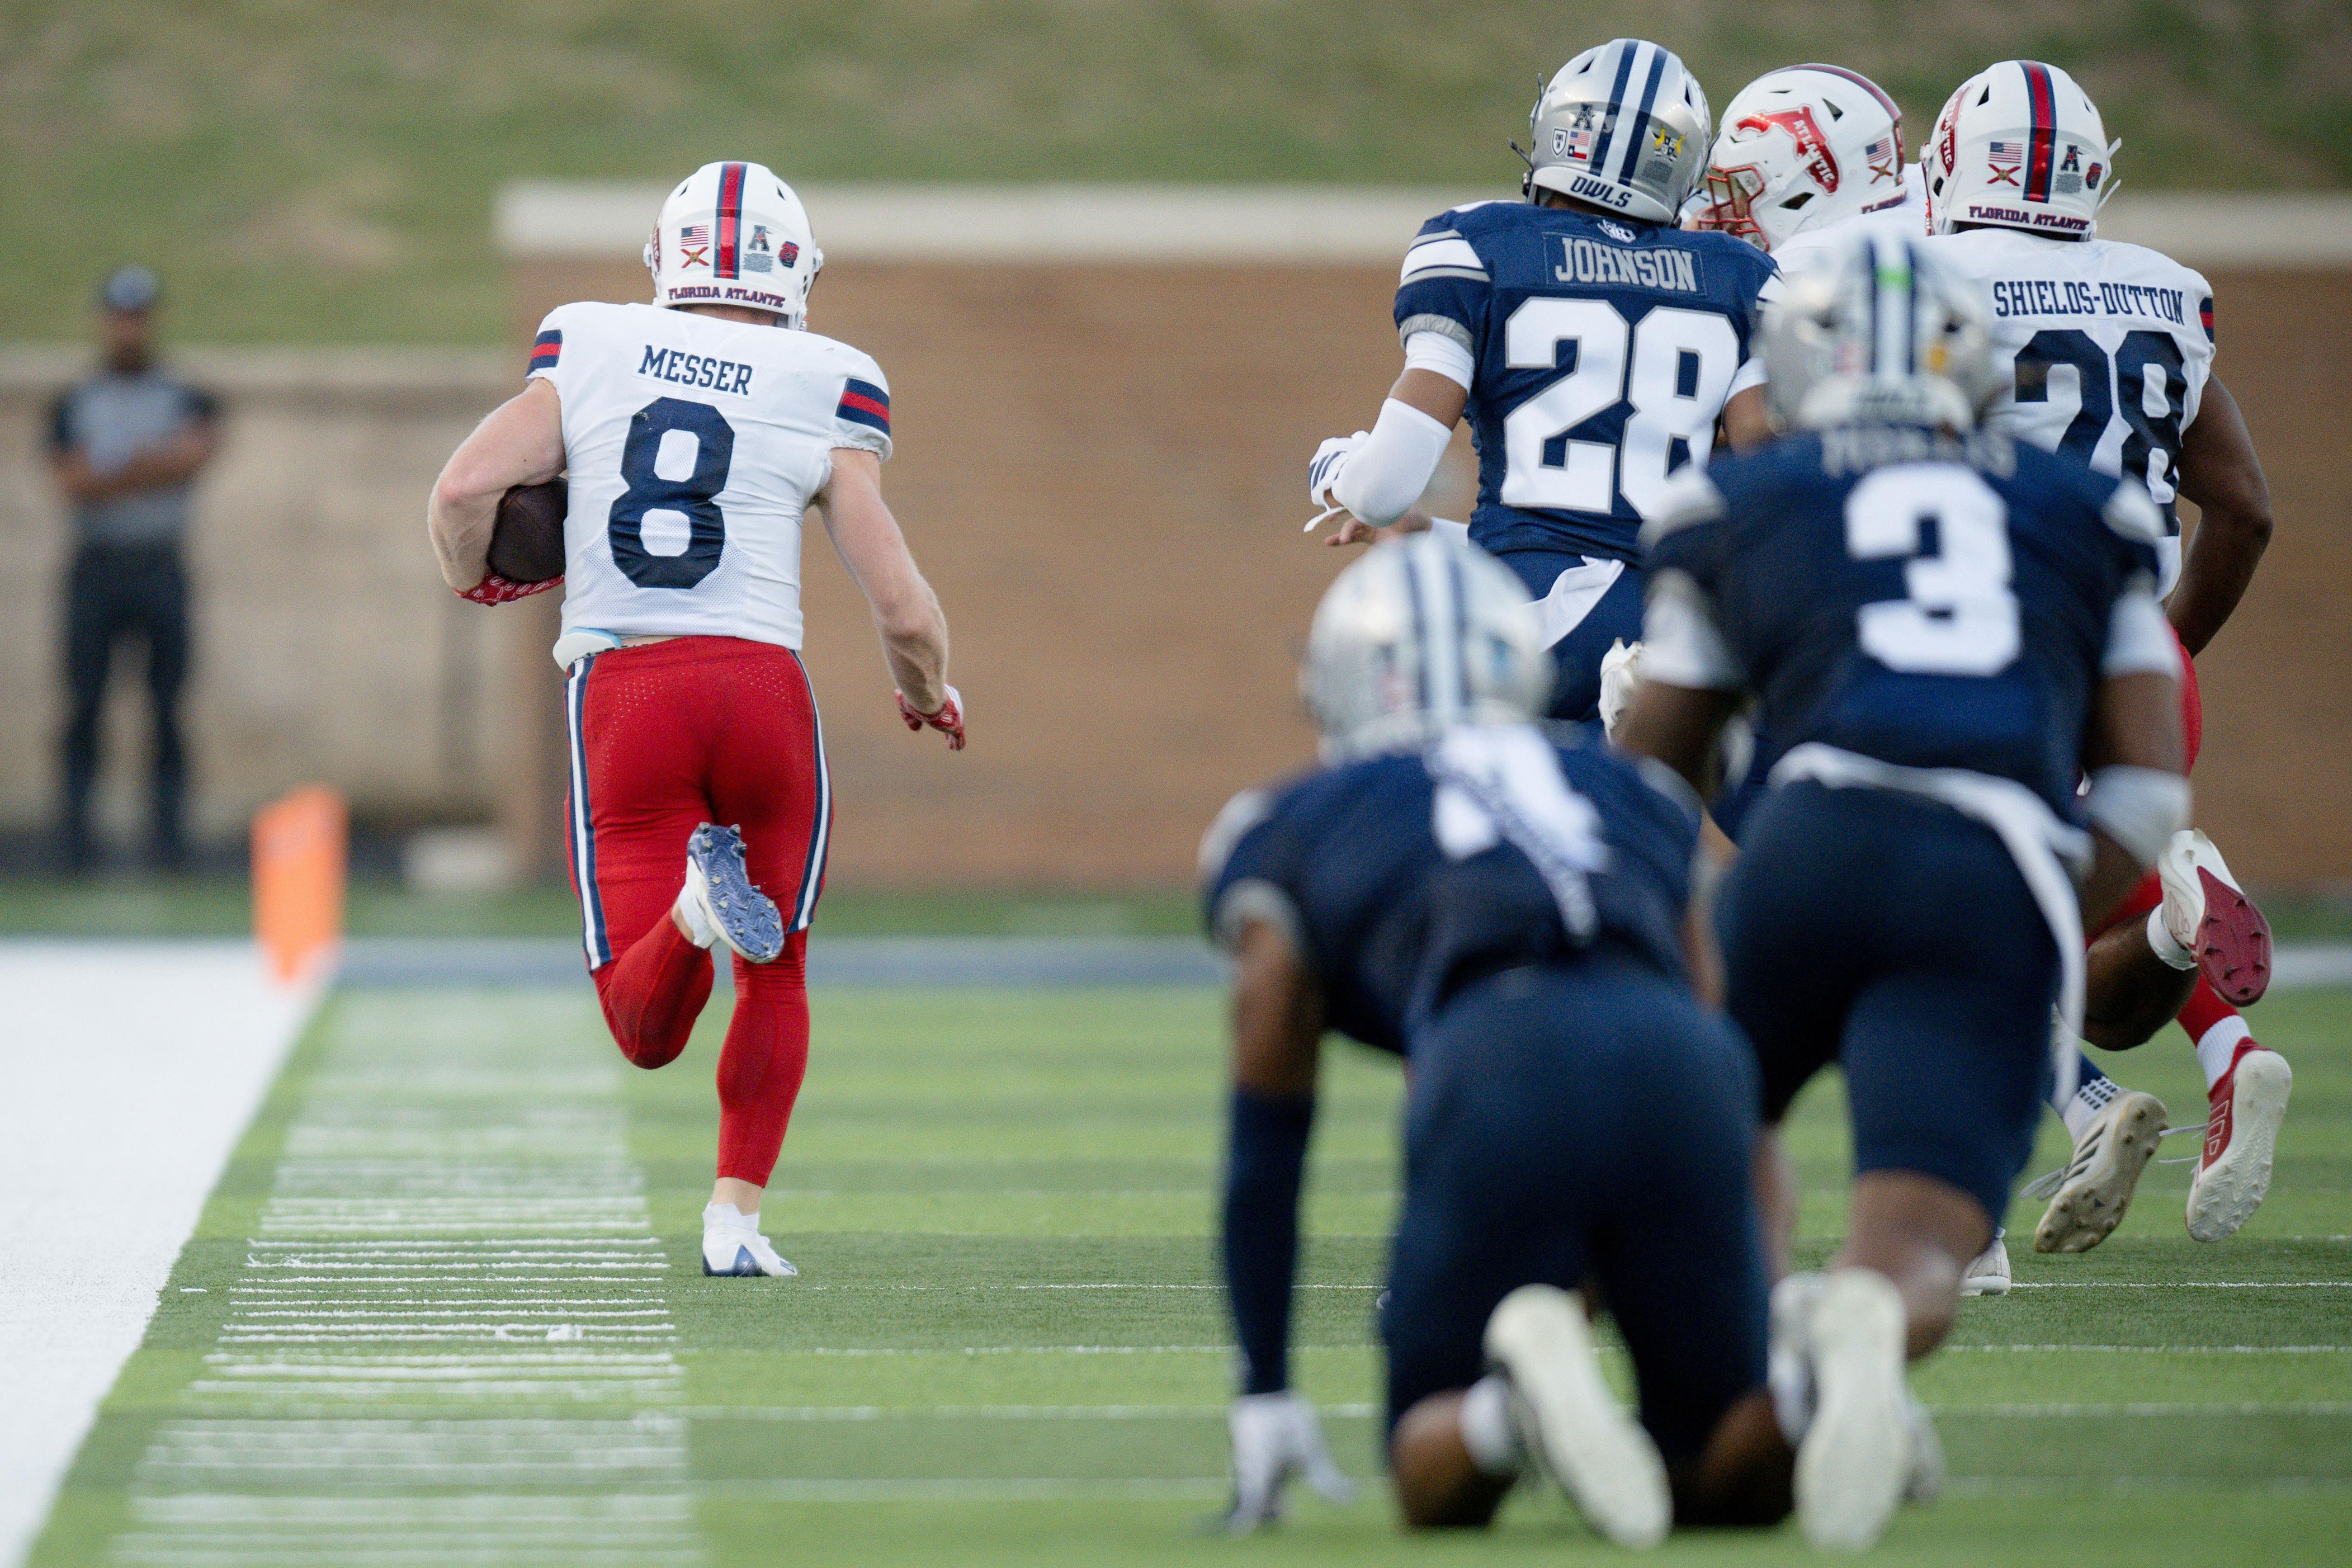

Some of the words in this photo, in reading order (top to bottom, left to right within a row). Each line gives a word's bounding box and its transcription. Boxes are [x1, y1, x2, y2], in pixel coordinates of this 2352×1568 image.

[1570, 176, 1632, 207] OWLS
[1969, 205, 2030, 224] FLORIDA
[1555, 237, 1698, 292] JOHNSON
[668, 286, 721, 300] FLORIDA
[1994, 280, 2185, 326] SHIELDS-DUTTON
[637, 344, 753, 396] MESSER
[1501, 296, 1740, 520] 28
[2014, 329, 2188, 537] 28
[607, 396, 735, 589] 8
[1844, 463, 2021, 677] 3
